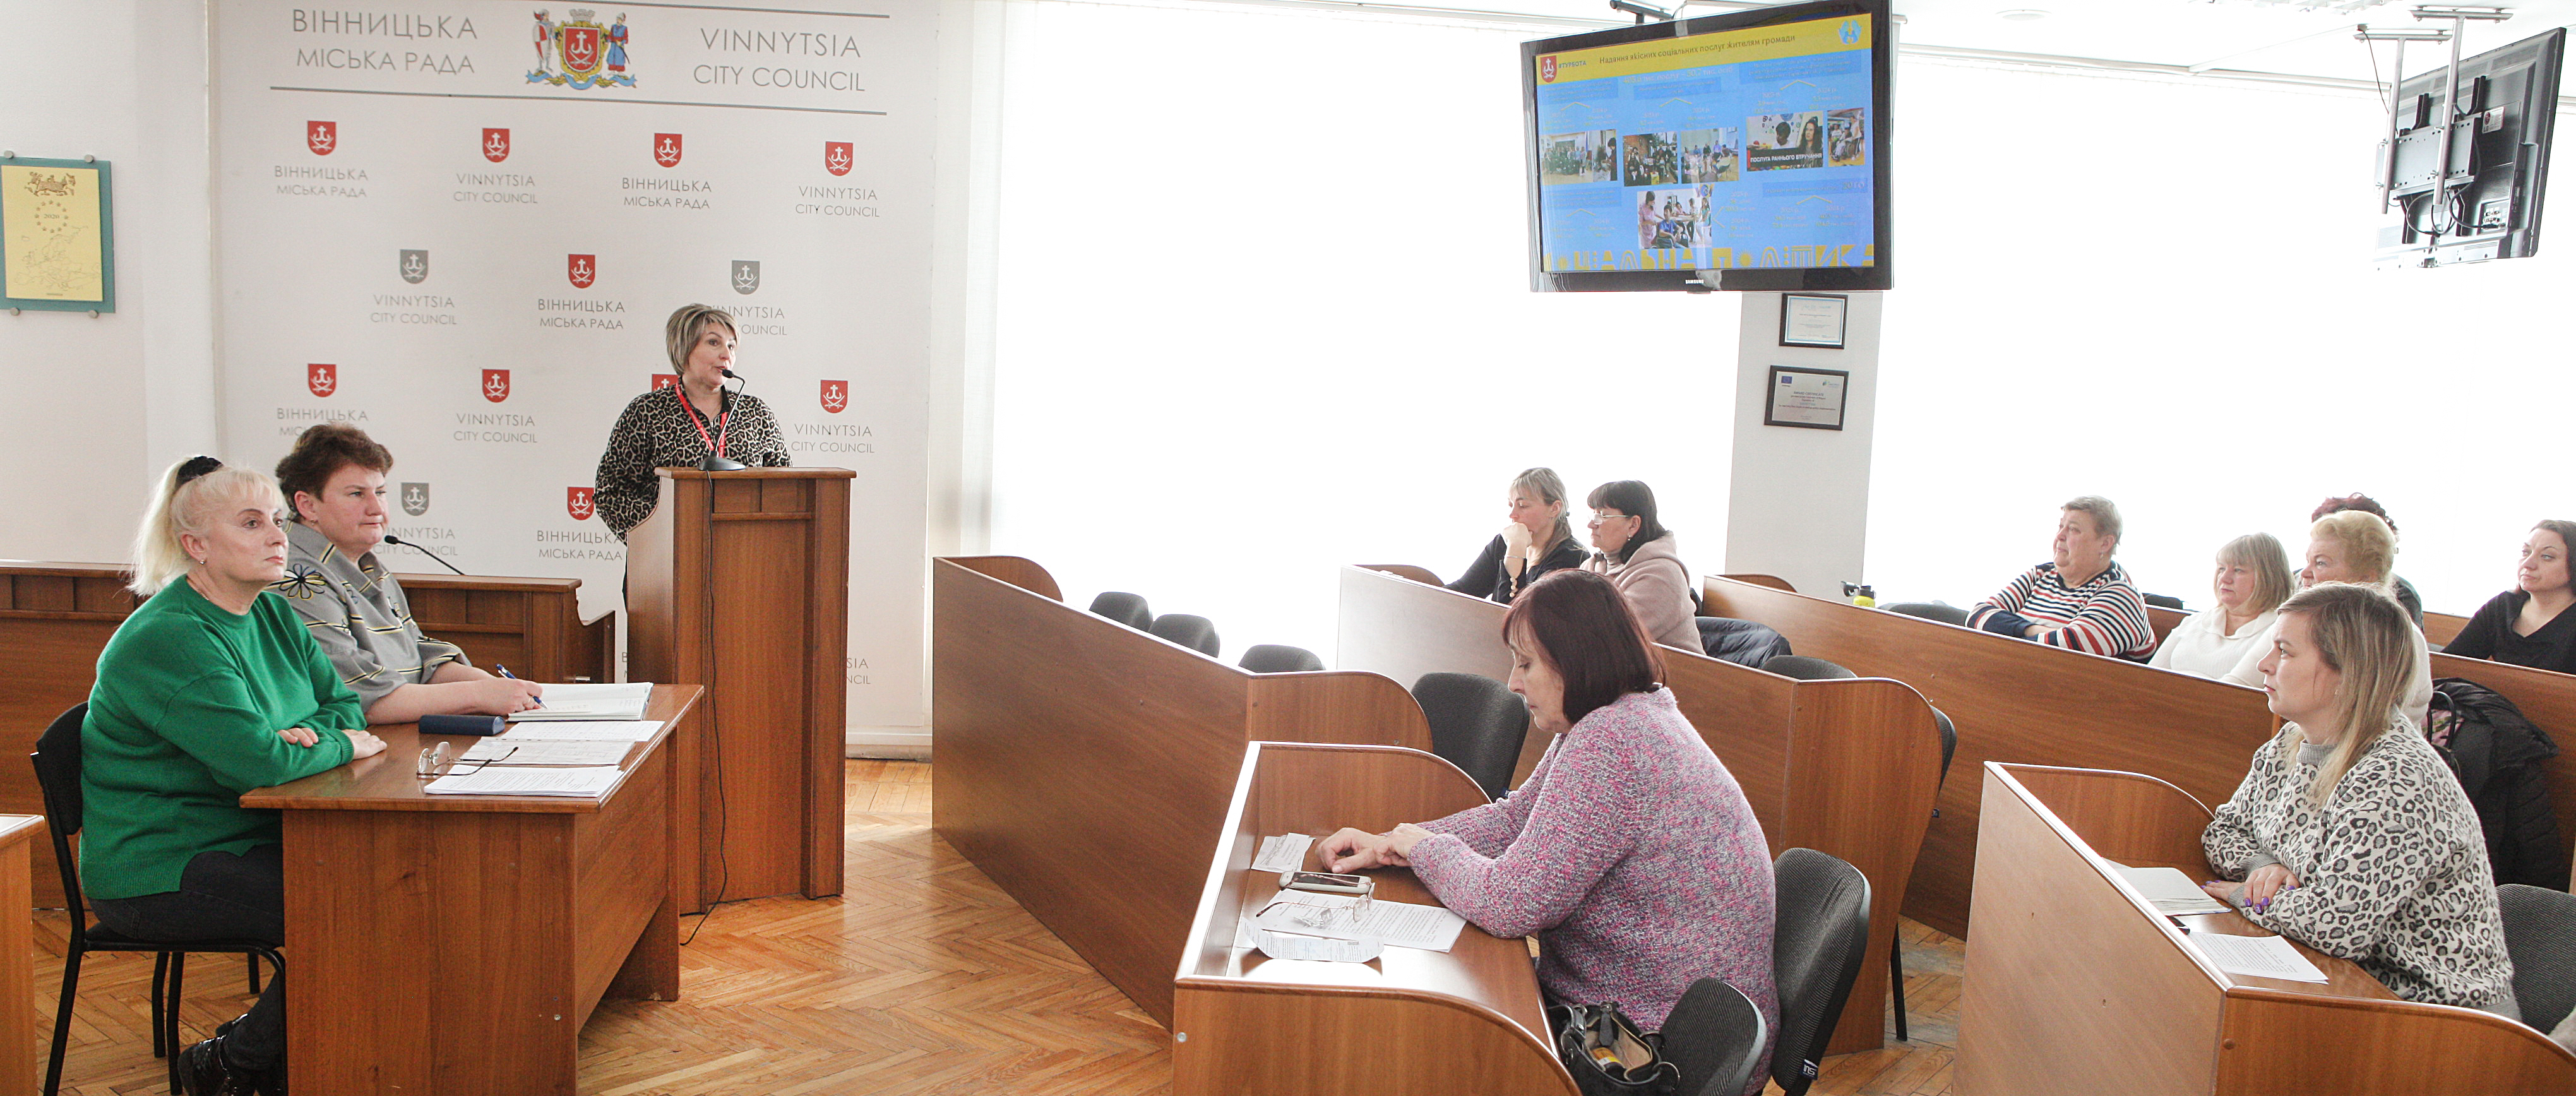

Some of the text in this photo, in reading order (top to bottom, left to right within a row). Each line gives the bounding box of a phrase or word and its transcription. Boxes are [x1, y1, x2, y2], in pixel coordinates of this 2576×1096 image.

[293, 9, 477, 40] ВІННИЦЬКА
[700, 28, 861, 57] VINNYTSIA
[1599, 35, 1795, 64] Надання якісних соціальних послуг жителям громади
[296, 48, 474, 75] МІСЬКА РАДА
[1559, 60, 1587, 69] #ТУРБОТА
[693, 64, 865, 91] CITY COUNCIL
[274, 165, 368, 180] ВІННИЦЬКА
[456, 173, 535, 186] VINNYTSIA
[622, 177, 712, 192] ВІННИЦЬКА
[276, 184, 366, 198] МІСЬКА РАДА
[453, 191, 538, 204] CITY COUNCIL
[798, 186, 877, 200] VINNYTSIA
[623, 196, 710, 210] МІСЬКА РАДА
[795, 203, 880, 217] CITY COUNCIL
[373, 294, 455, 307] VINNYTSIA
[537, 298, 625, 313] ВІННИЦЬКА
[369, 312, 457, 325] CITY COUNCIL
[713, 306, 785, 319] NNYTSIA
[539, 317, 623, 330] МІСЬКА РАДА
[738, 324, 788, 336] OUNCIL
[277, 407, 368, 421] ВІННИЦЬКА
[456, 413, 535, 426] VINNYTSIA
[794, 423, 872, 436] VINNYTSIA
[453, 430, 537, 443] CITY COUNCIL
[790, 441, 874, 453] CITY COUNCIL
[387, 527, 456, 539] INNYTSIA
[373, 544, 398, 554] CITY
[539, 548, 623, 561] МІСЬКА РАДА
